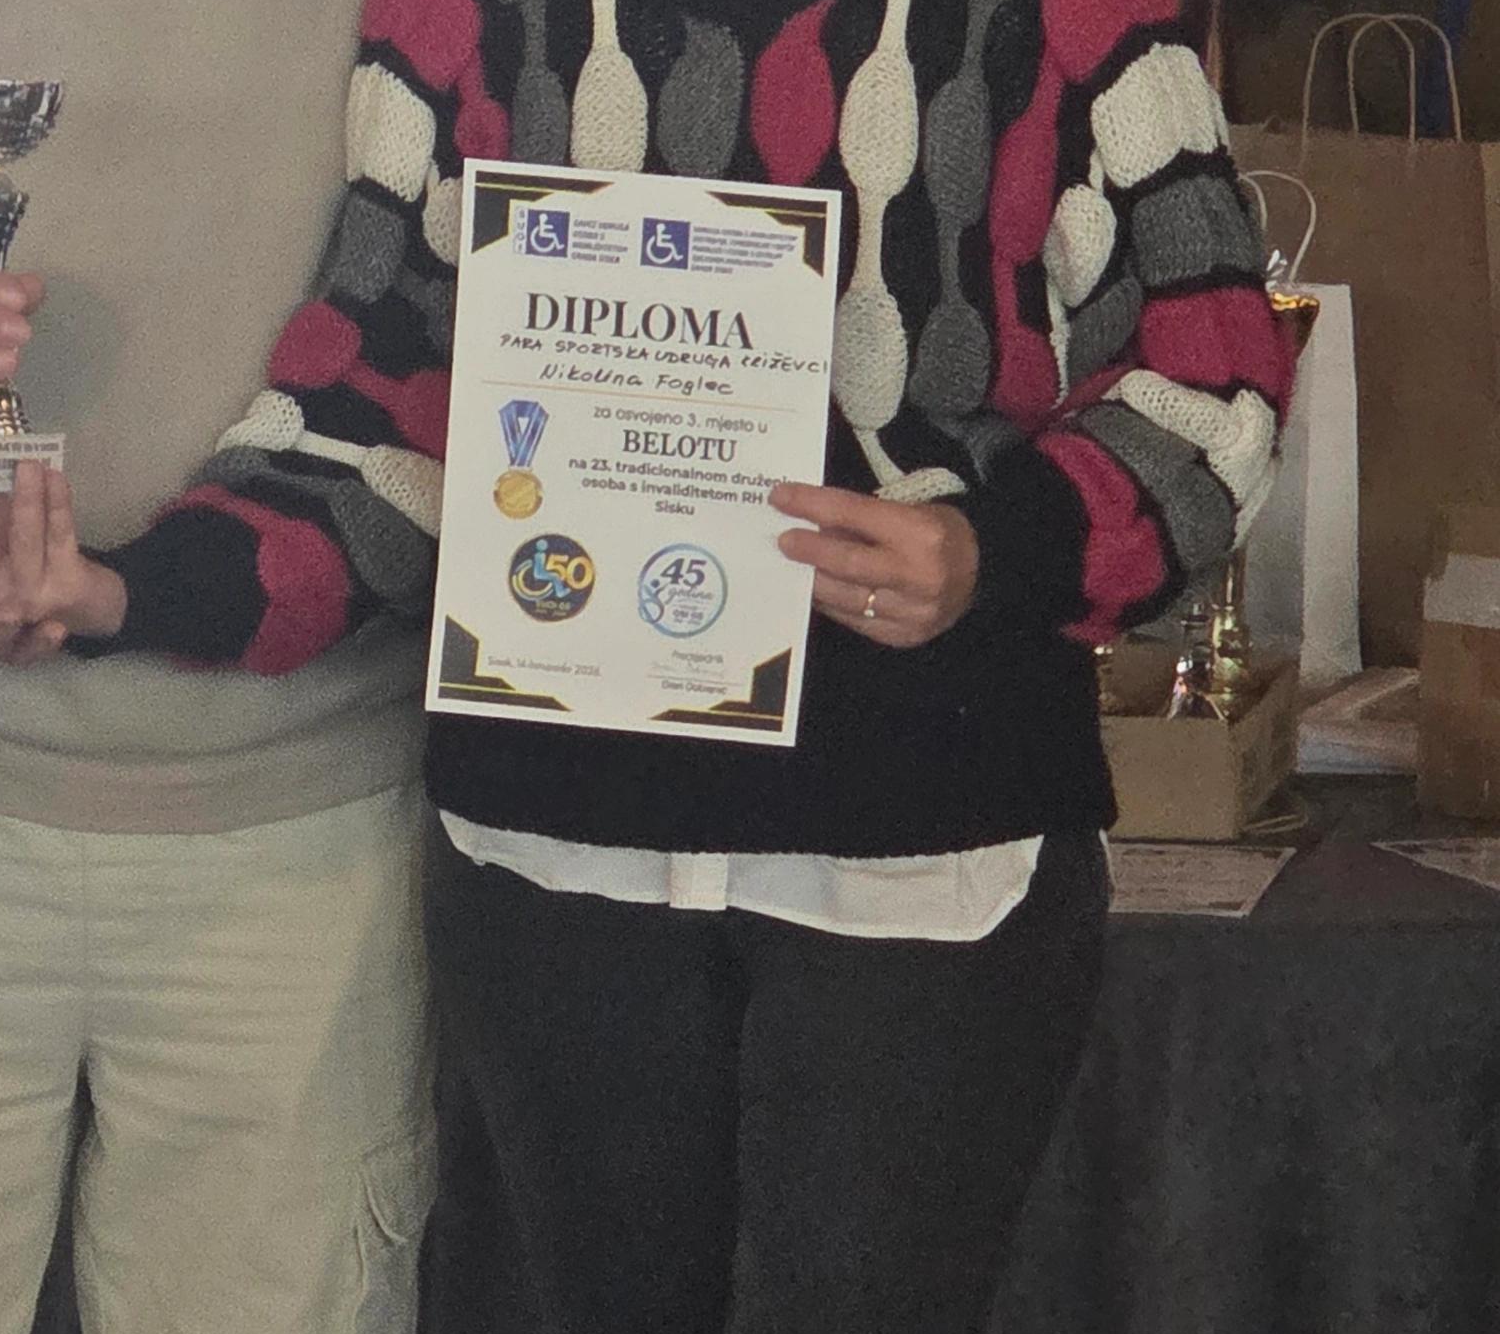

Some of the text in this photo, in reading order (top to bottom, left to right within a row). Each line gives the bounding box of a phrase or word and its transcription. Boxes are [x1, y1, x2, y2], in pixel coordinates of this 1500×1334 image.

[525, 291, 754, 350] DIPLOMA
[500, 333, 542, 352] PARA
[554, 338, 649, 361] SPORTSKA
[654, 349, 731, 369] UDRUGA
[593, 405, 769, 434] za osvojeno 3. mjesto u
[622, 428, 738, 463] BELOTU
[568, 457, 798, 490] na 23. tradicionalnom družen
[581, 476, 627, 491] osoba
[641, 480, 738, 503] invaliditetom
[741, 491, 764, 505] RH
[654, 500, 696, 516] Sisku
[546, 554, 595, 590] 50
[660, 557, 707, 588] 45
